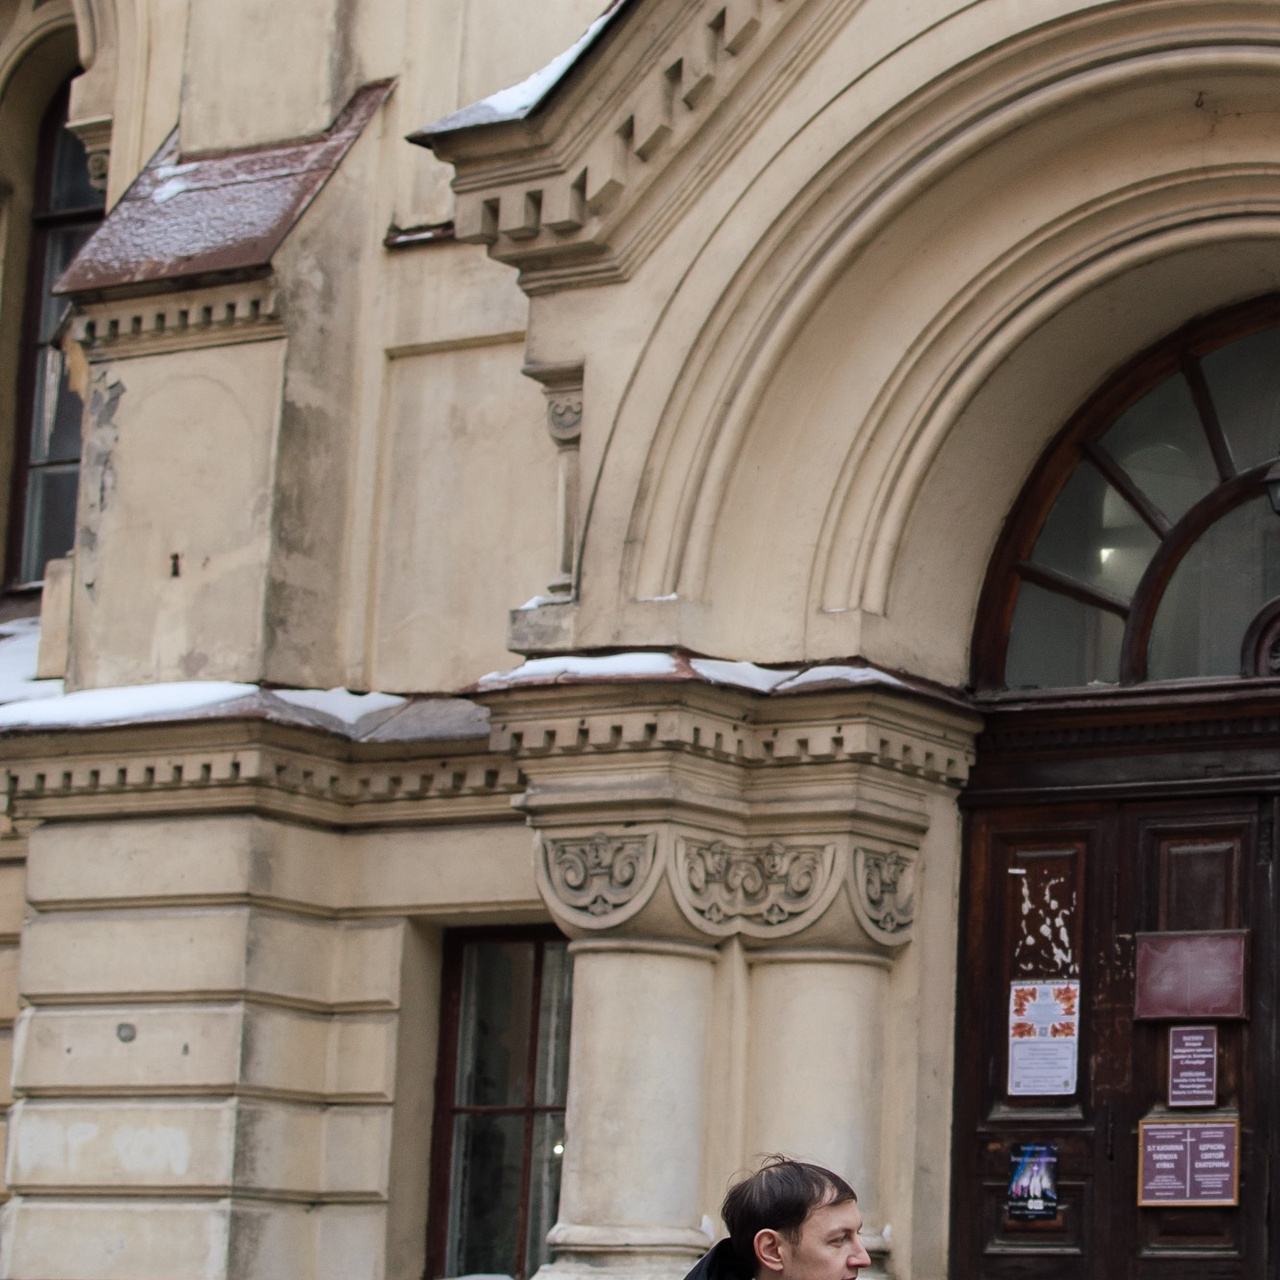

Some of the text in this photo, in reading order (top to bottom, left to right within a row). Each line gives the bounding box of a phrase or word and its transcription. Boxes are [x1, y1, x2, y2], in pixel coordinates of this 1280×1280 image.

[1156, 1144, 1184, 1152] KATARINA
[1199, 1143, 1226, 1151] ЦЕРКОВЬ
[1152, 1153, 1178, 1161] SVENSKA
[1200, 1151, 1224, 1160] СВЯТОЙ
[1194, 1161, 1230, 1169] ЕКАТЕРИНЫ
